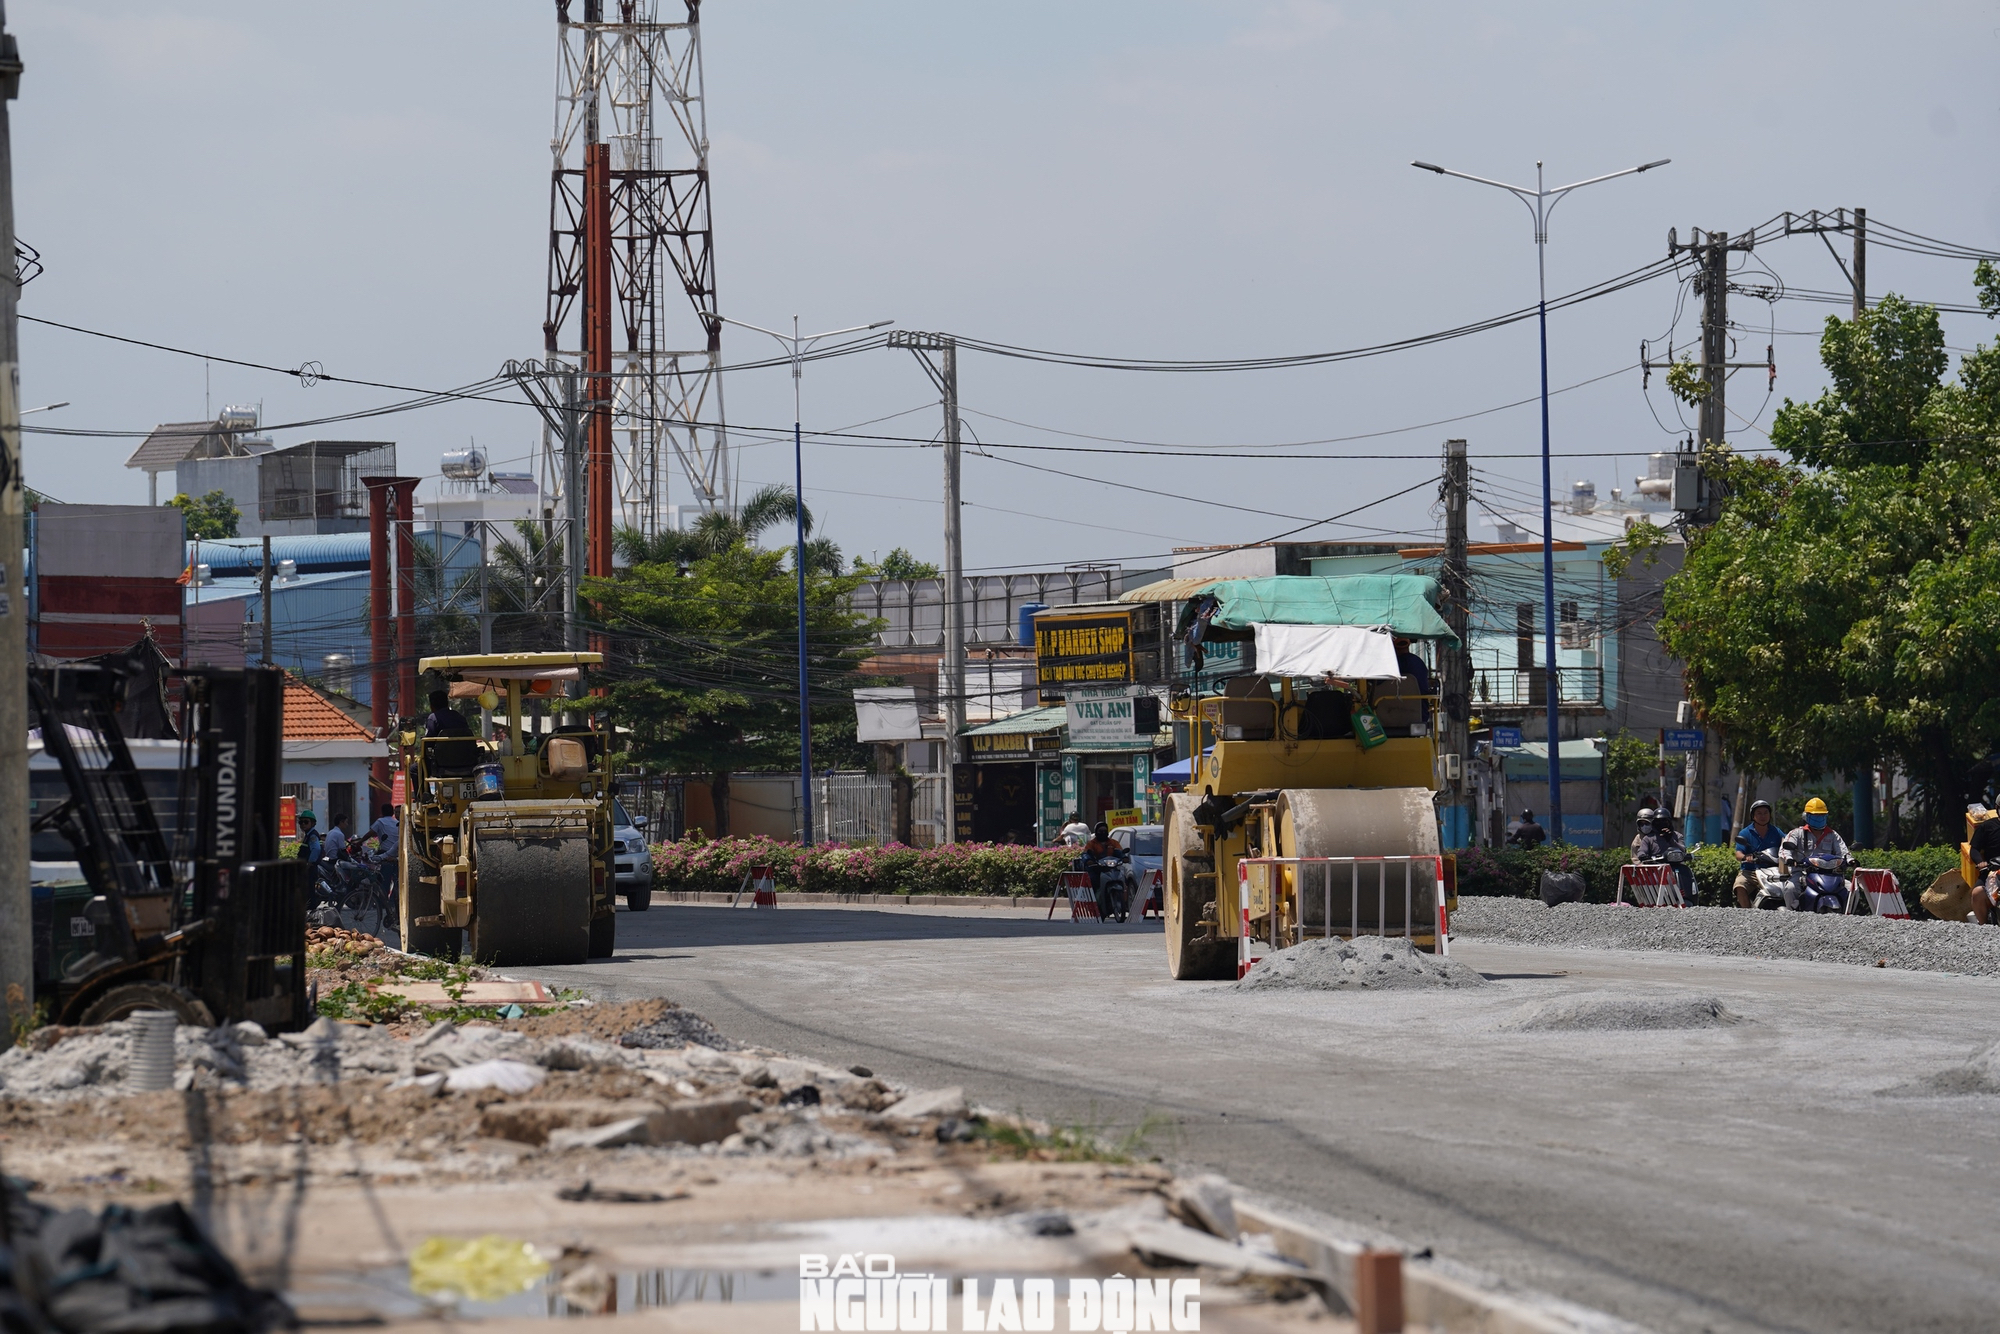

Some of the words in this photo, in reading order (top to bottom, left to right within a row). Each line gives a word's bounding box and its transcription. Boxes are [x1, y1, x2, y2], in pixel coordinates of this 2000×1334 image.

[1058, 628, 1098, 656] BARBER
[1098, 627, 1124, 654] SHOP
[993, 735, 1026, 751] BARBER
[216, 741, 237, 857] HYUNDAI
[1568, 827, 1602, 835] SmartHeart
